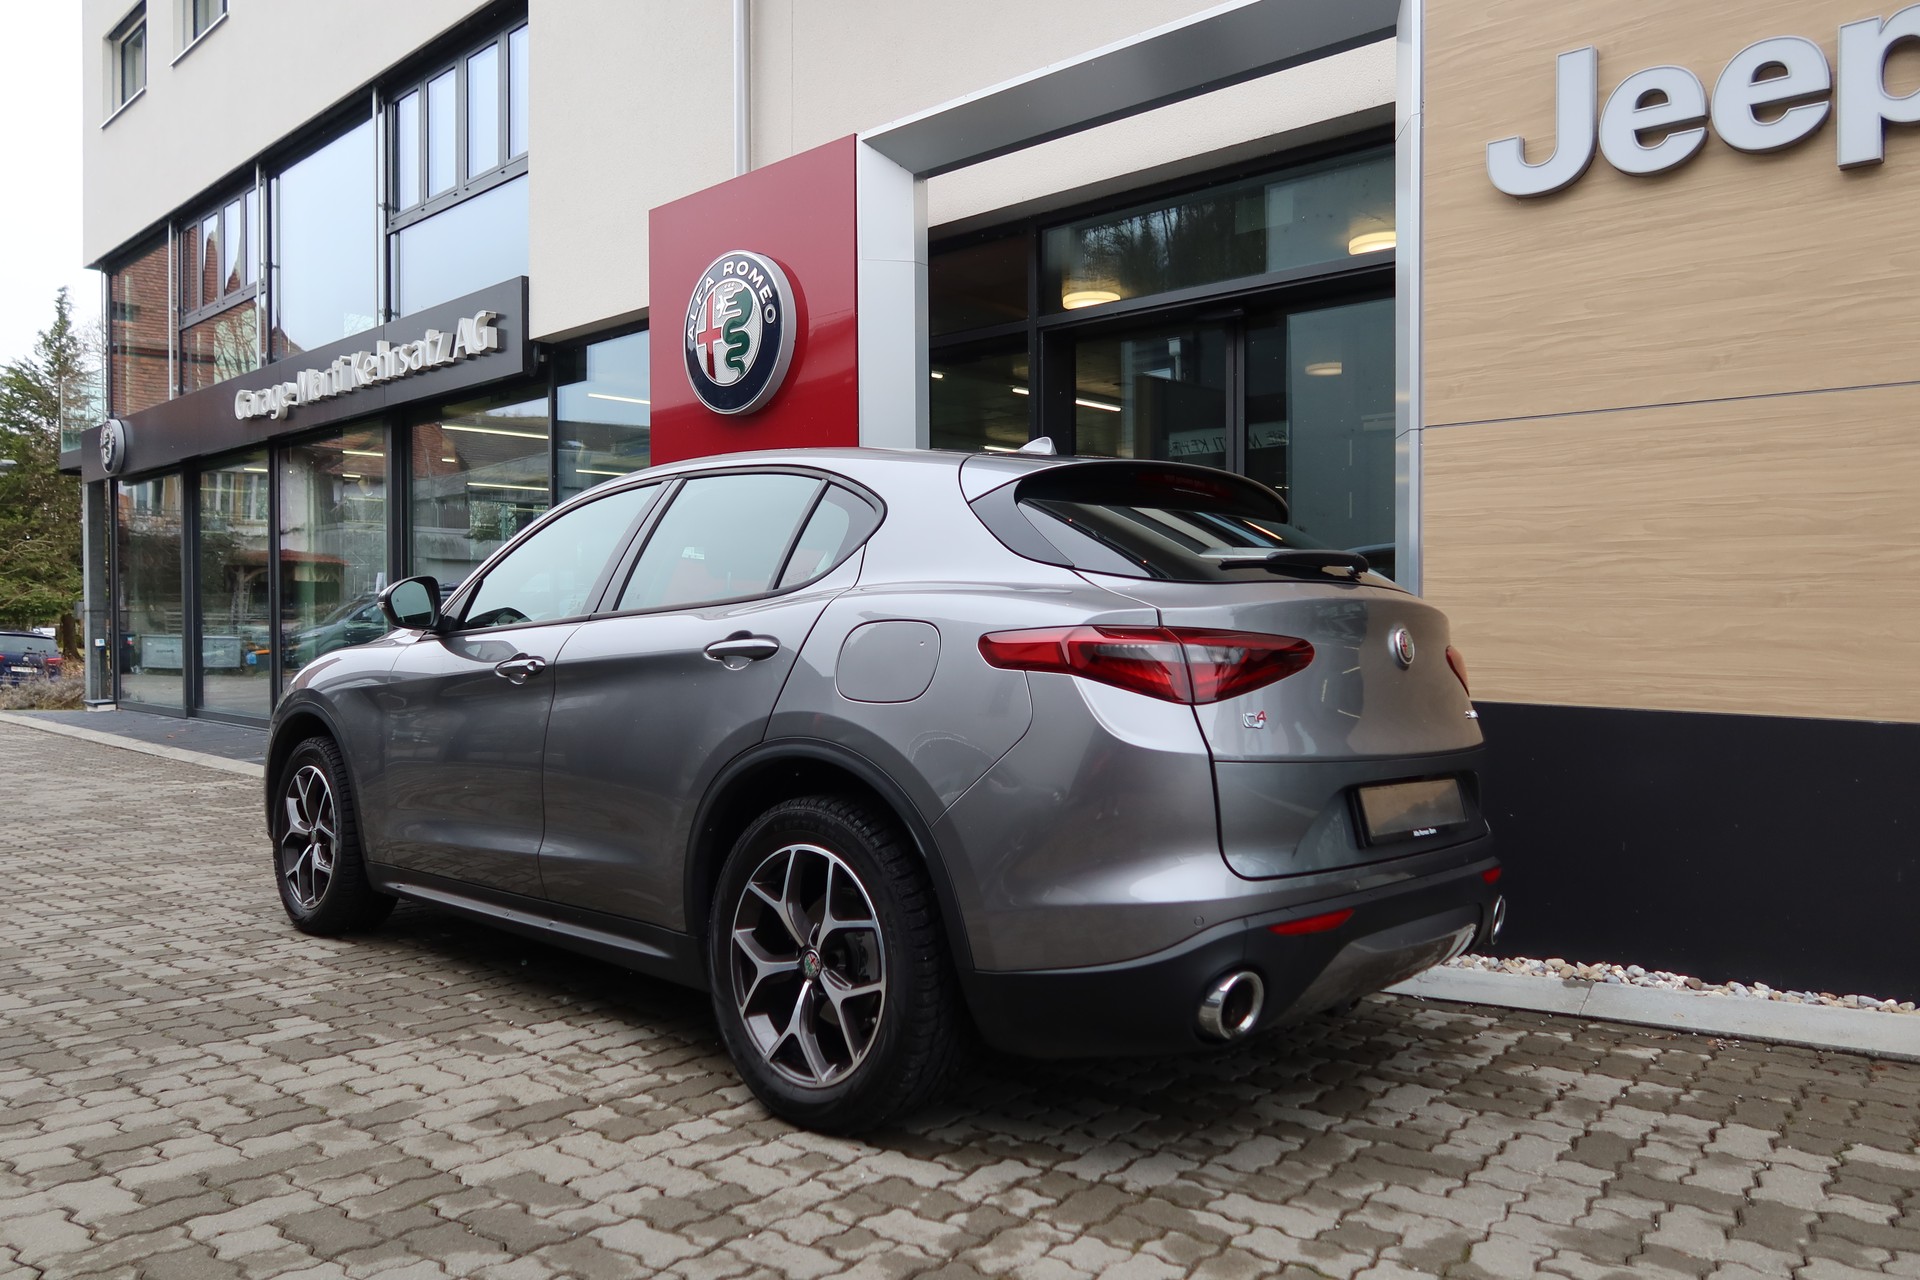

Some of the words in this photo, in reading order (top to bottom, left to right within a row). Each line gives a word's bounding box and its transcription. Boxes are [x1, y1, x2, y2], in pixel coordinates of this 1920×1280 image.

[1486, 4, 1920, 198] Jeep
[687, 276, 715, 341] ALFA
[722, 260, 777, 324] ROMEO
[235, 382, 298, 420] Garage
[351, 328, 455, 389] Kehrsatz
[454, 310, 498, 360] AG
